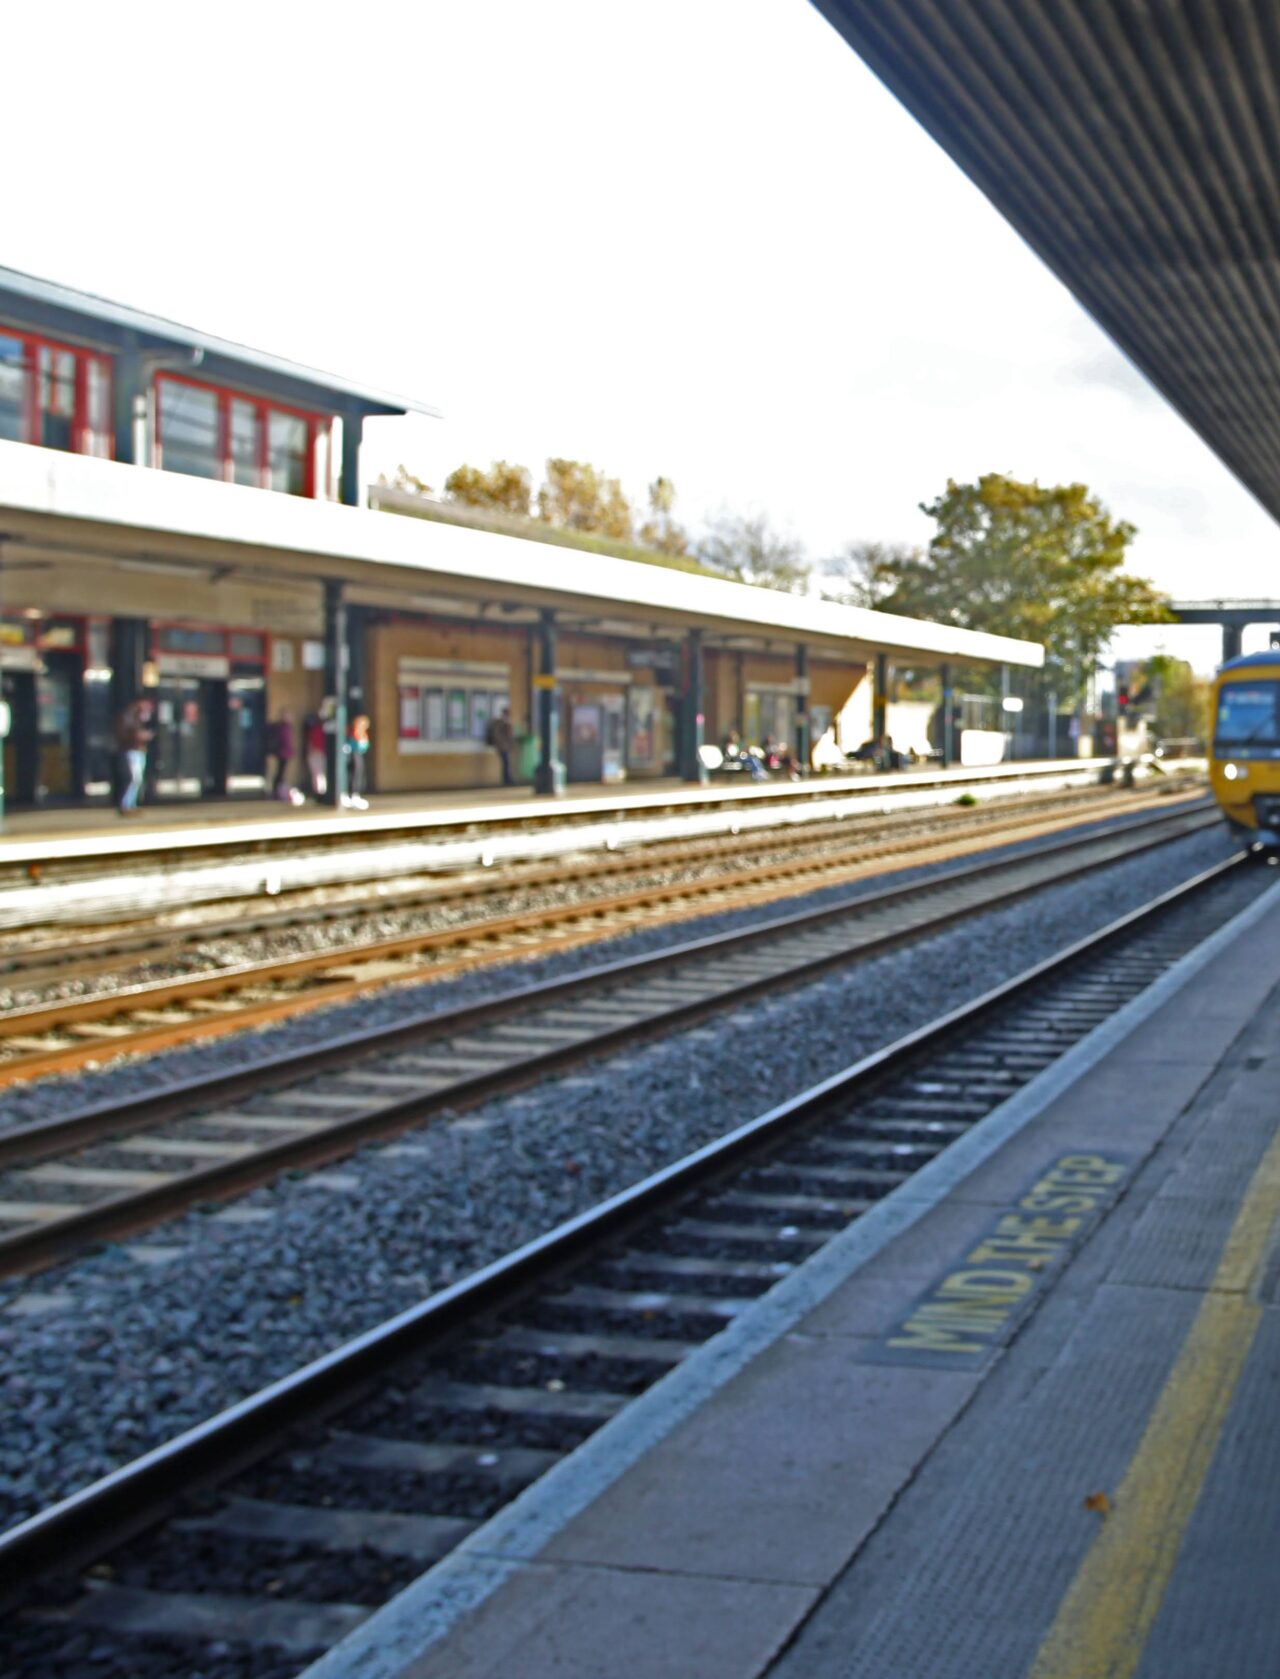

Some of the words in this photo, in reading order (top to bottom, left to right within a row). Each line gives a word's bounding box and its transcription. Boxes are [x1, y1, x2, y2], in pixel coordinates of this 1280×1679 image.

[1019, 1154, 1126, 1214] STEP
[967, 1214, 1081, 1264] THE
[886, 1269, 1033, 1352] MIND
